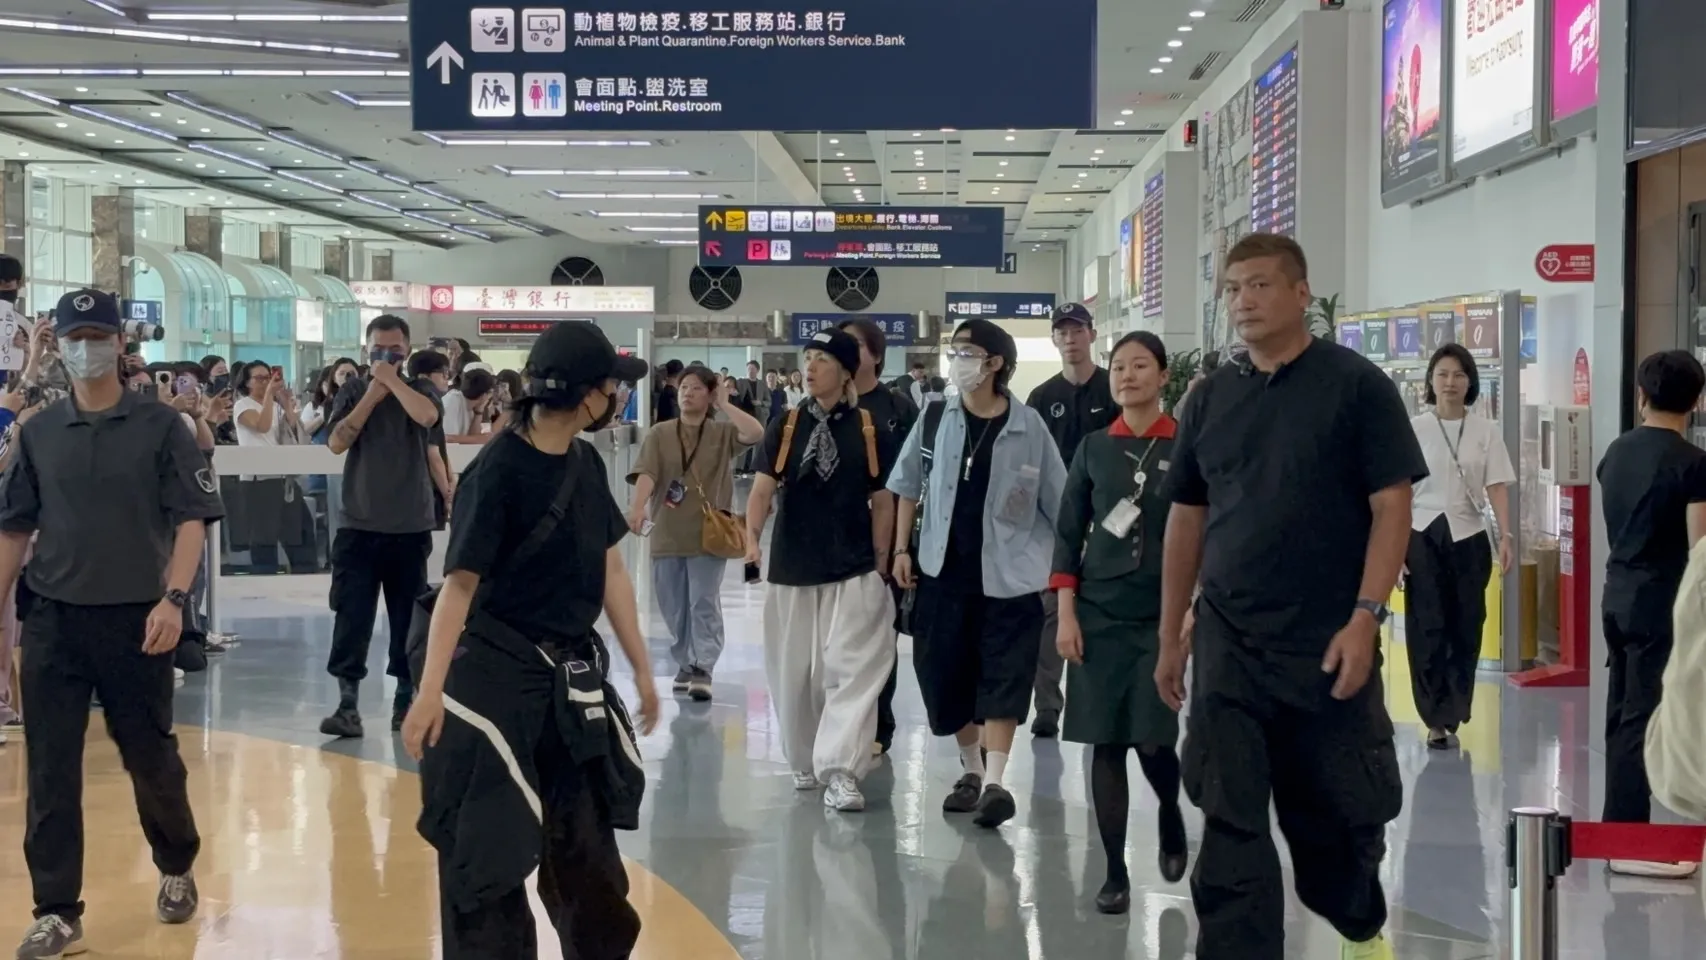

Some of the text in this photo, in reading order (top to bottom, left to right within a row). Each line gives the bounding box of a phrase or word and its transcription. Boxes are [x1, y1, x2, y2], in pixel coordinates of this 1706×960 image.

[574, 35, 905, 49] Animal & Plant Quarantine.Foreign Workers Service.Bank
[574, 78, 708, 97] 會面點.盥洗室
[574, 100, 722, 114] Meeting Point.Restroom
[753, 243, 763, 257] P
[477, 288, 572, 309] 臺灣銀行
